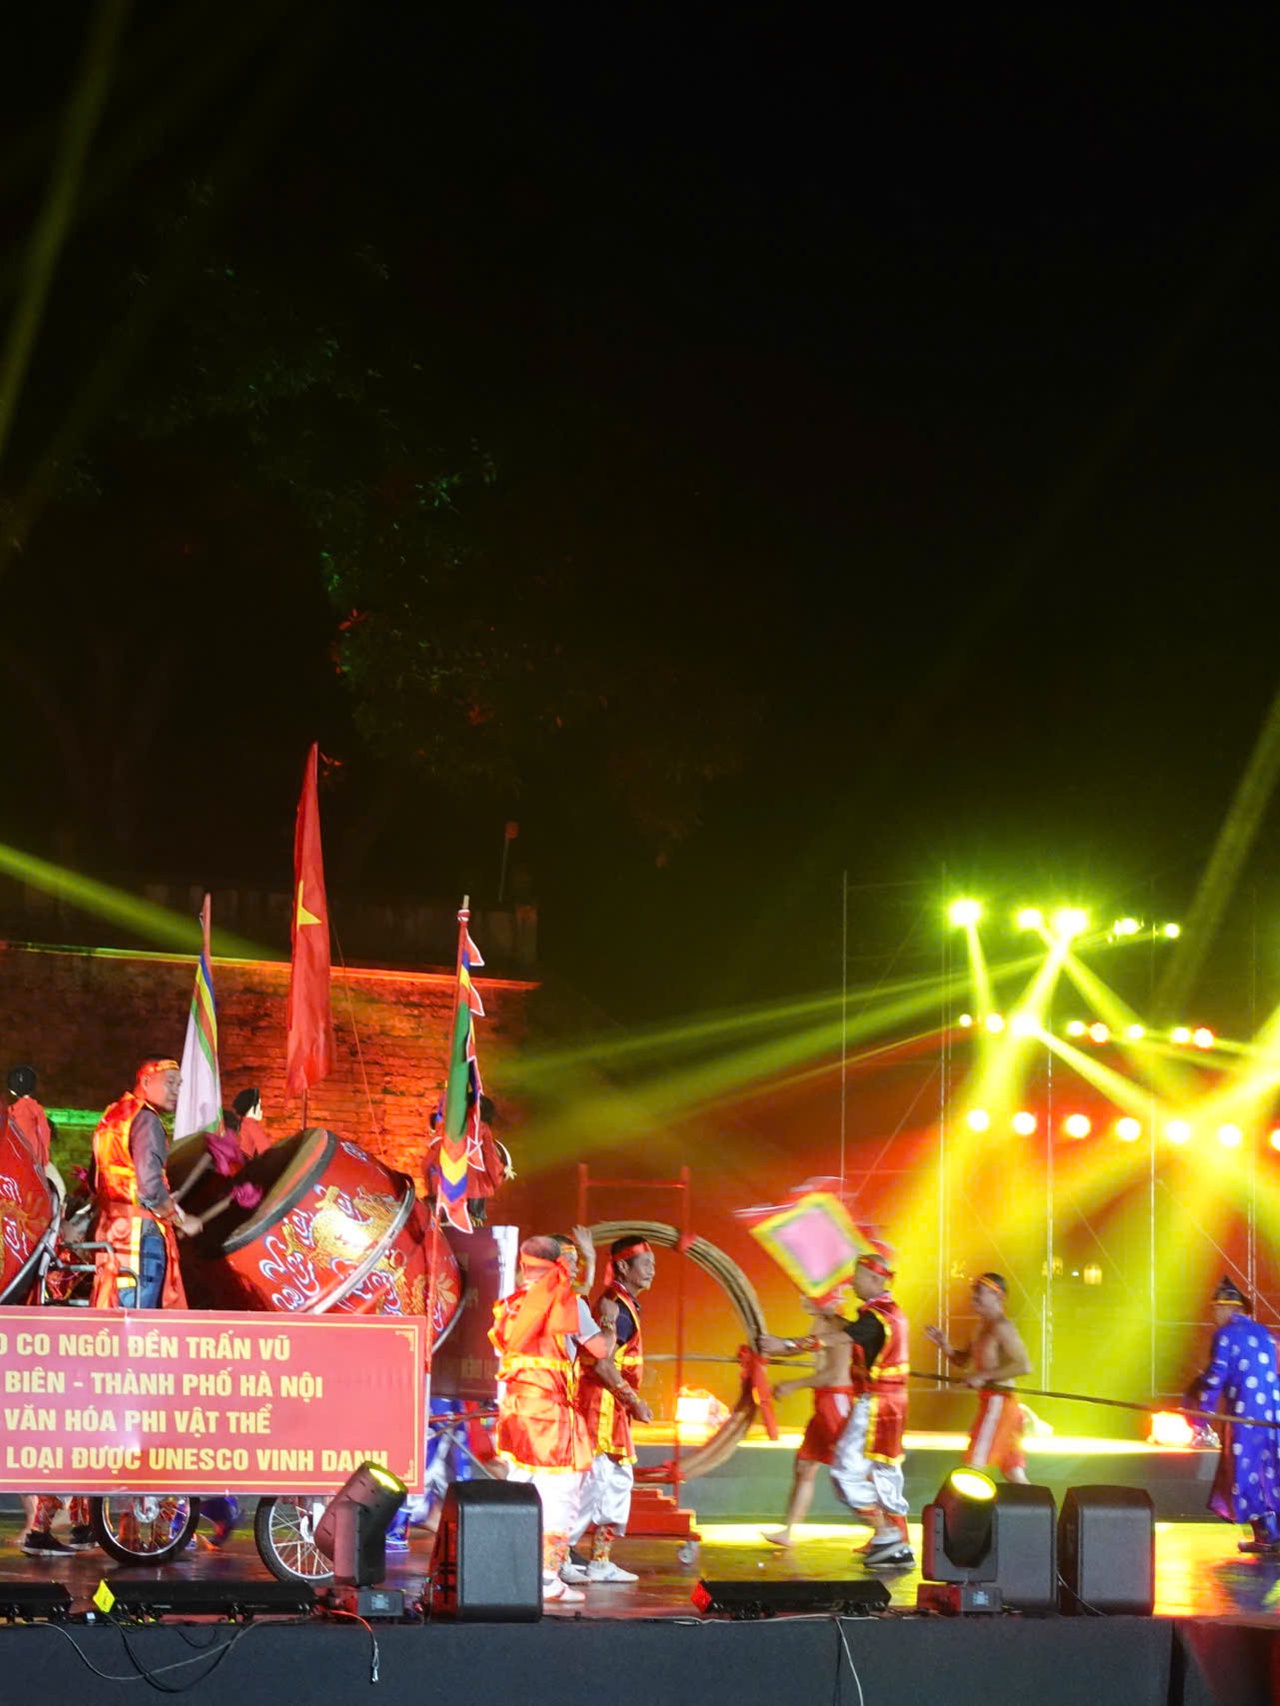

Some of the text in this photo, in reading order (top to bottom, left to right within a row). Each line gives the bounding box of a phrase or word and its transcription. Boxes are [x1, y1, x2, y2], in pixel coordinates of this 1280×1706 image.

[16, 1333, 50, 1356] CO
[59, 1328, 119, 1357] NGỒI
[128, 1329, 179, 1358] ĐỀN
[186, 1330, 252, 1360] TRẤN
[258, 1334, 291, 1361] VŨ
[5, 1367, 65, 1393] BIÊN
[91, 1368, 174, 1395] THÀNH
[182, 1367, 233, 1397] PHỐ
[239, 1371, 273, 1397] HÀ
[280, 1372, 323, 1403] NỘI
[4, 1404, 57, 1431] VĂN
[65, 1405, 117, 1432] HÓA
[124, 1410, 166, 1432] PHI
[174, 1407, 220, 1438] VẬT
[225, 1403, 272, 1434] THỂ
[6, 1447, 64, 1474] LOẠI
[71, 1446, 142, 1475] ĐƯỢC
[149, 1447, 250, 1472] UNESCO
[256, 1449, 314, 1472] VINH
[321, 1449, 389, 1472] DANH
